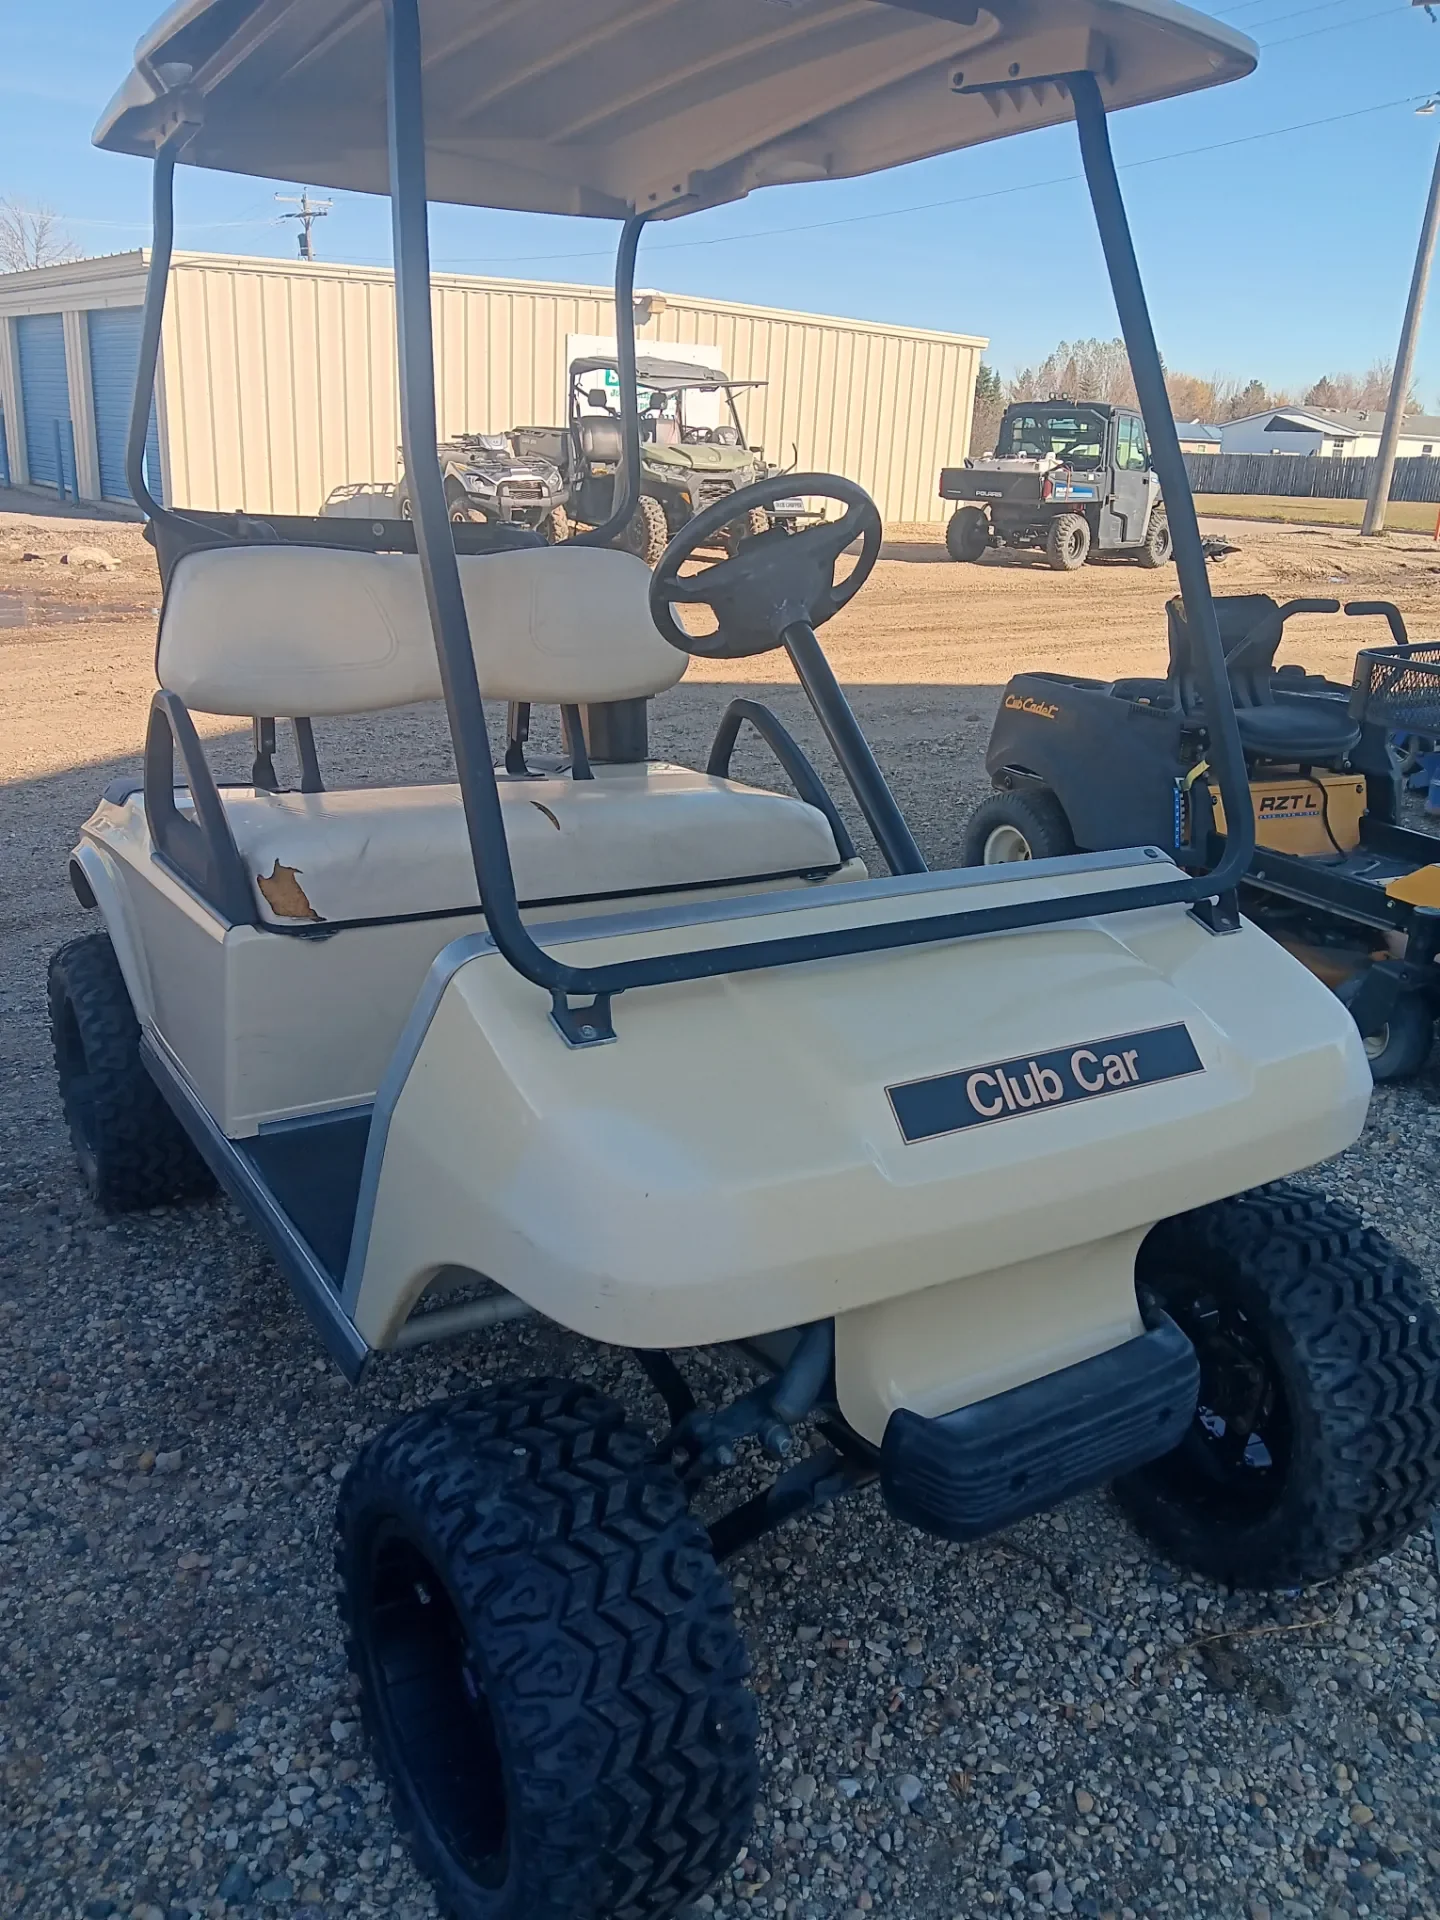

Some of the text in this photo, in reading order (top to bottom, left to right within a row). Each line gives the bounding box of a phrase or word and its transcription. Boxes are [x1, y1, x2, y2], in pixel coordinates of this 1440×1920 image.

[1023, 697, 1058, 718] Cadet
[965, 1049, 1140, 1116] Club Car
